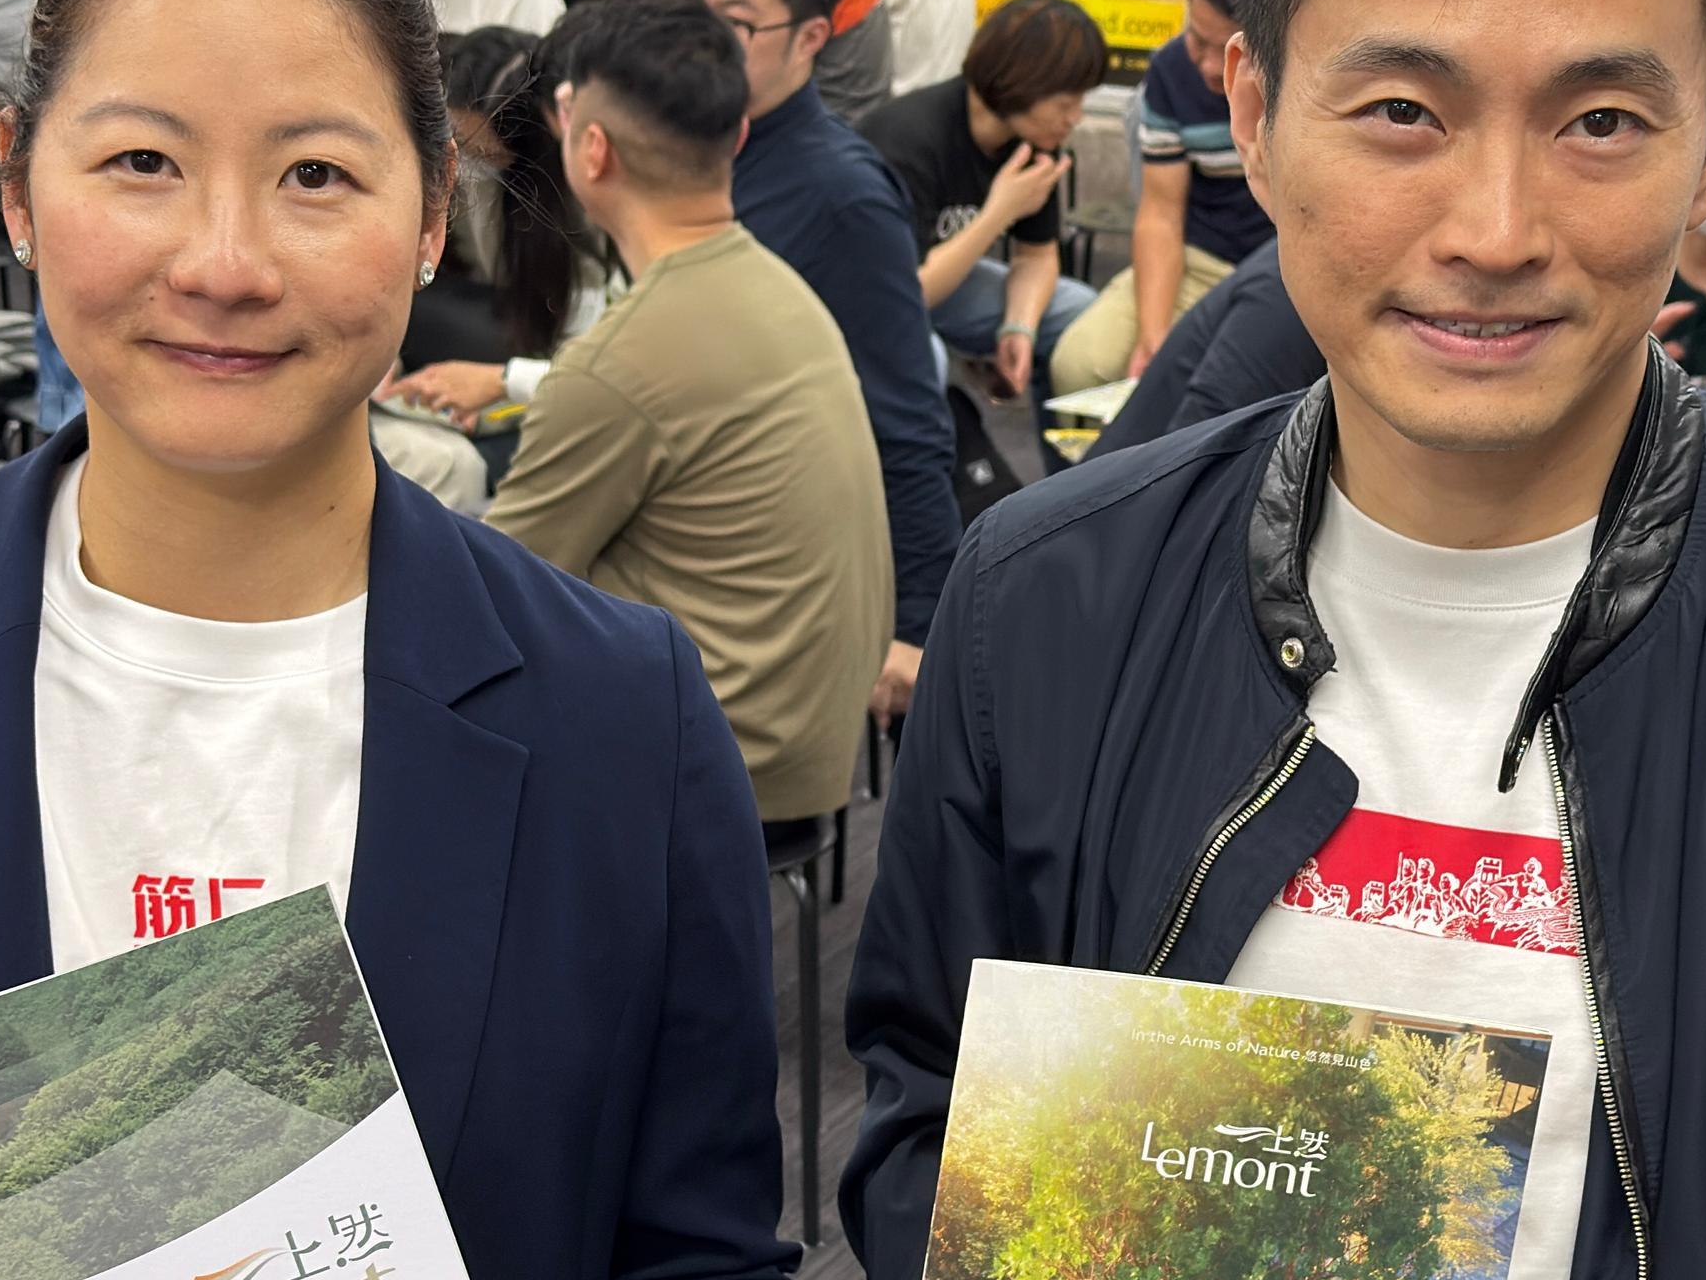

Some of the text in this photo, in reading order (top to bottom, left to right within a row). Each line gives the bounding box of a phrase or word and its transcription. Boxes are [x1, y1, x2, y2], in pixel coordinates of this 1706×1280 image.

[1132, 1028, 1145, 1041] In
[1148, 1030, 1174, 1045] the
[1180, 1033, 1221, 1050] Arms
[1226, 1038, 1243, 1052] of
[1246, 1042, 1300, 1061] Nature
[1141, 1121, 1321, 1198] Lemont
